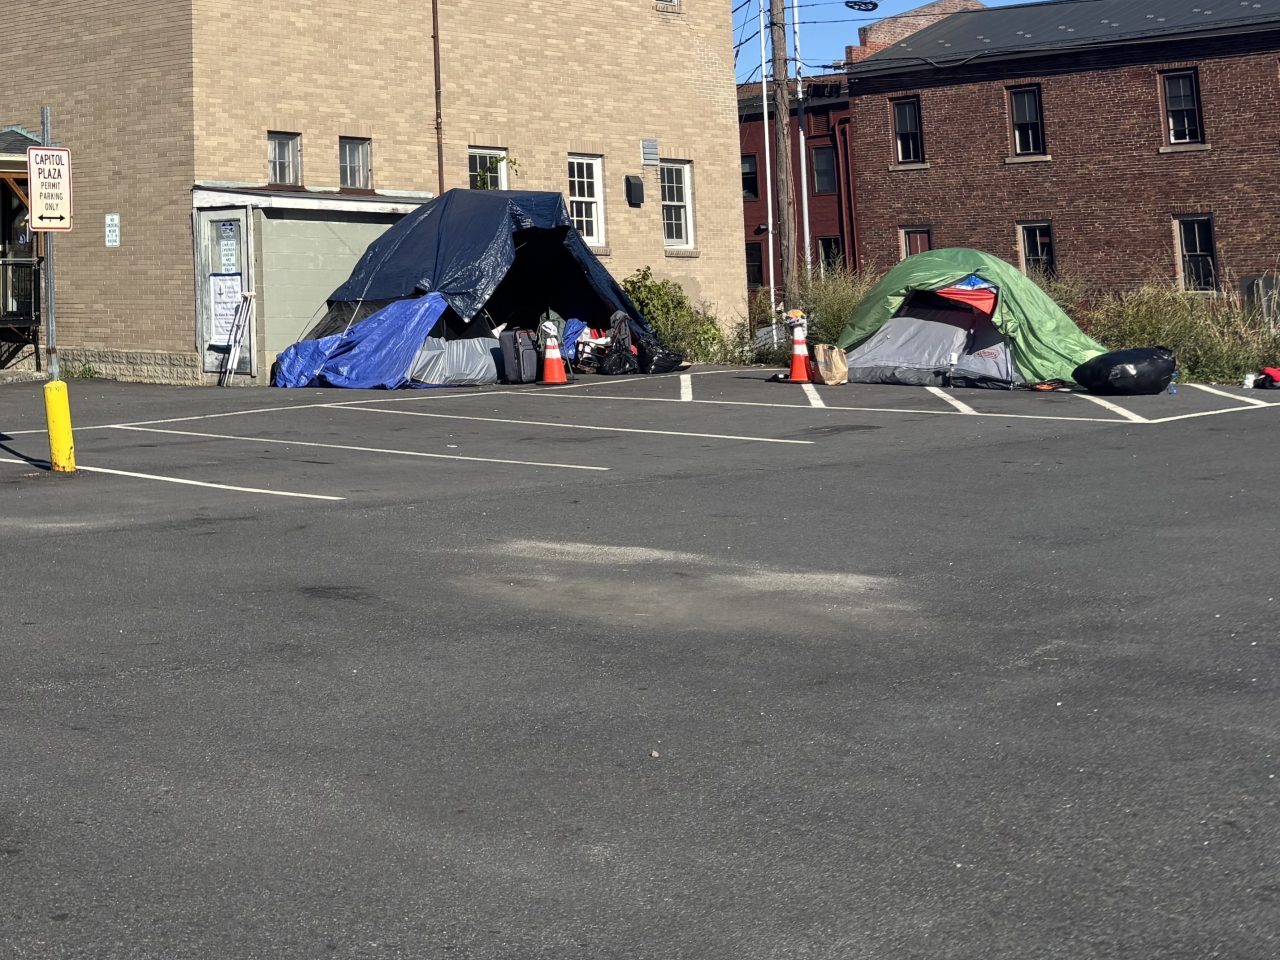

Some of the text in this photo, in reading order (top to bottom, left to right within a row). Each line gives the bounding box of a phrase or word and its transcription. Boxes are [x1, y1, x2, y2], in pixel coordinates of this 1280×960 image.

[34, 154, 65, 166] CAPITOL
[38, 168, 62, 179] PLAZA
[40, 182, 61, 190] PERMIT
[39, 192, 63, 201] PARKING
[44, 203, 59, 211] ONLY
